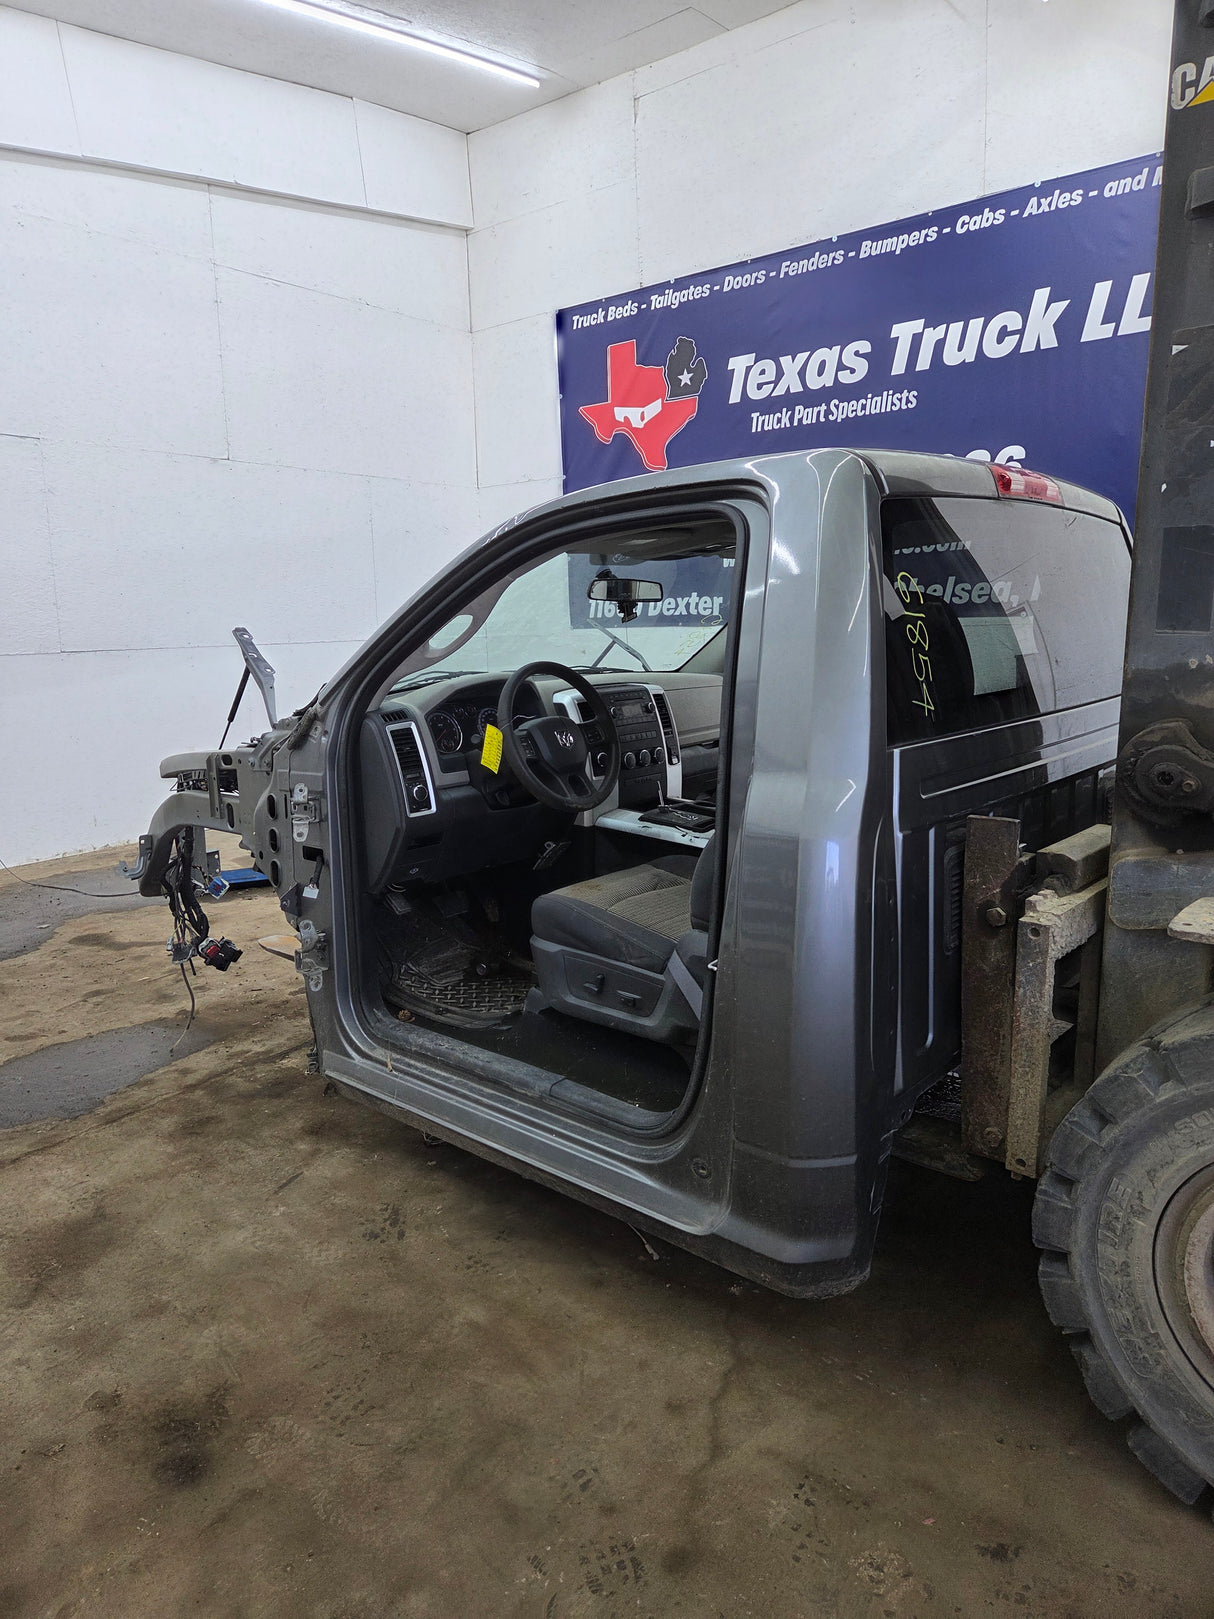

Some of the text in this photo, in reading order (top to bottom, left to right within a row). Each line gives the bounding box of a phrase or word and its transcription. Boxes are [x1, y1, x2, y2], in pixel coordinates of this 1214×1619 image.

[572, 307, 605, 330] Truck
[606, 300, 638, 322] Beds
[650, 282, 711, 310] Tailgates
[722, 268, 767, 292] Doors
[779, 248, 845, 278] Fenders
[858, 225, 938, 259] Bumpers
[955, 207, 1006, 234] Cabs
[1022, 189, 1084, 218] Axles
[1103, 167, 1149, 198] and
[726, 272, 1152, 405] Texas Truck LL
[751, 389, 918, 433] Truck Part Specialists
[647, 592, 724, 617] Dexter
[897, 571, 936, 717] 61854
